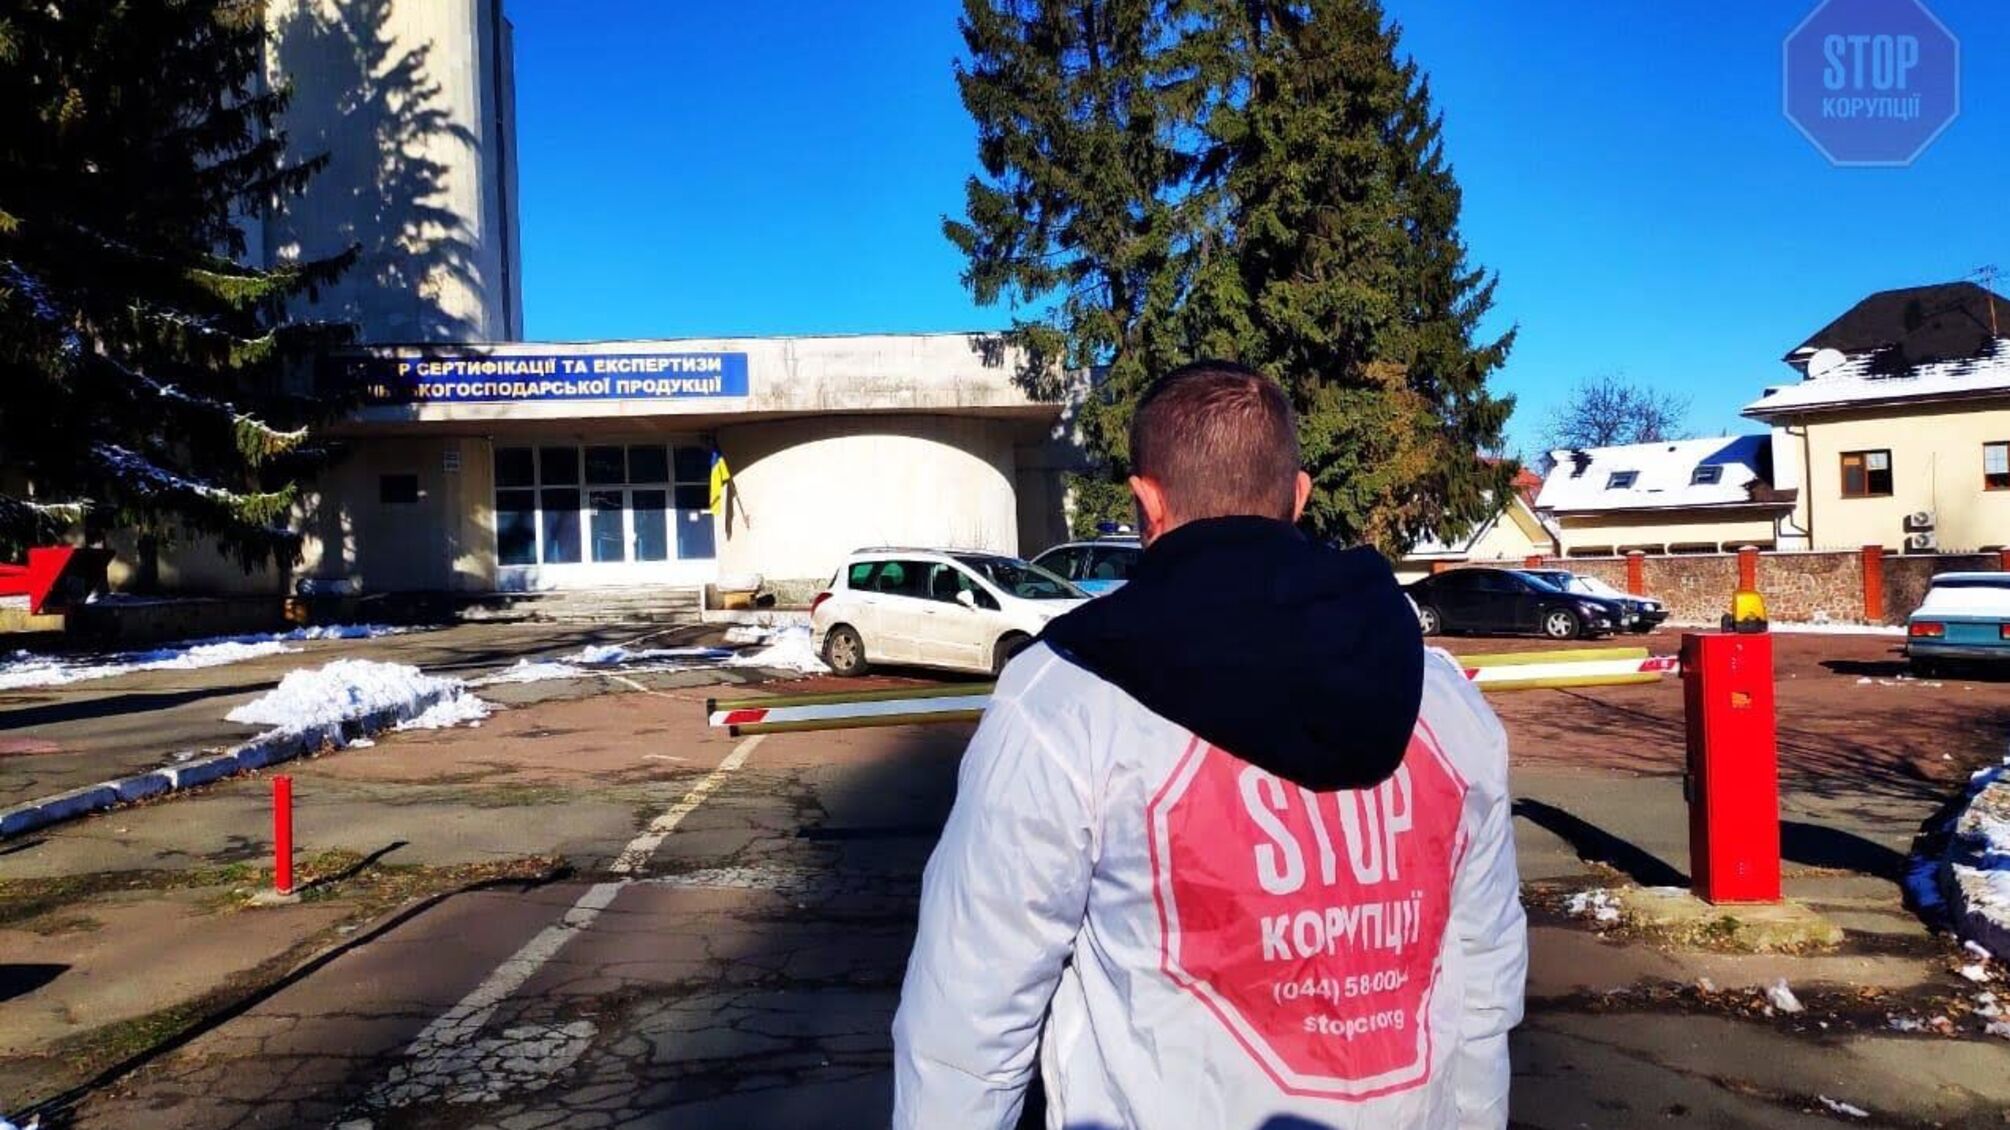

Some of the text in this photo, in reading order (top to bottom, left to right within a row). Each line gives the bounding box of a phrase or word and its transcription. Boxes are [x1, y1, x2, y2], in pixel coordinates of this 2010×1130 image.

[416, 359, 556, 376] СЕРТИФІКАЦІЇ
[562, 360, 588, 373] ТА
[593, 357, 722, 373] ЕКСПЕРТИЗИ
[616, 376, 722, 395] ПРОДУКЦІЇ
[1239, 764, 1412, 895] STOP
[1260, 890, 1423, 961] КОРУПЦІЇ
[1273, 977, 1339, 1006] (044)
